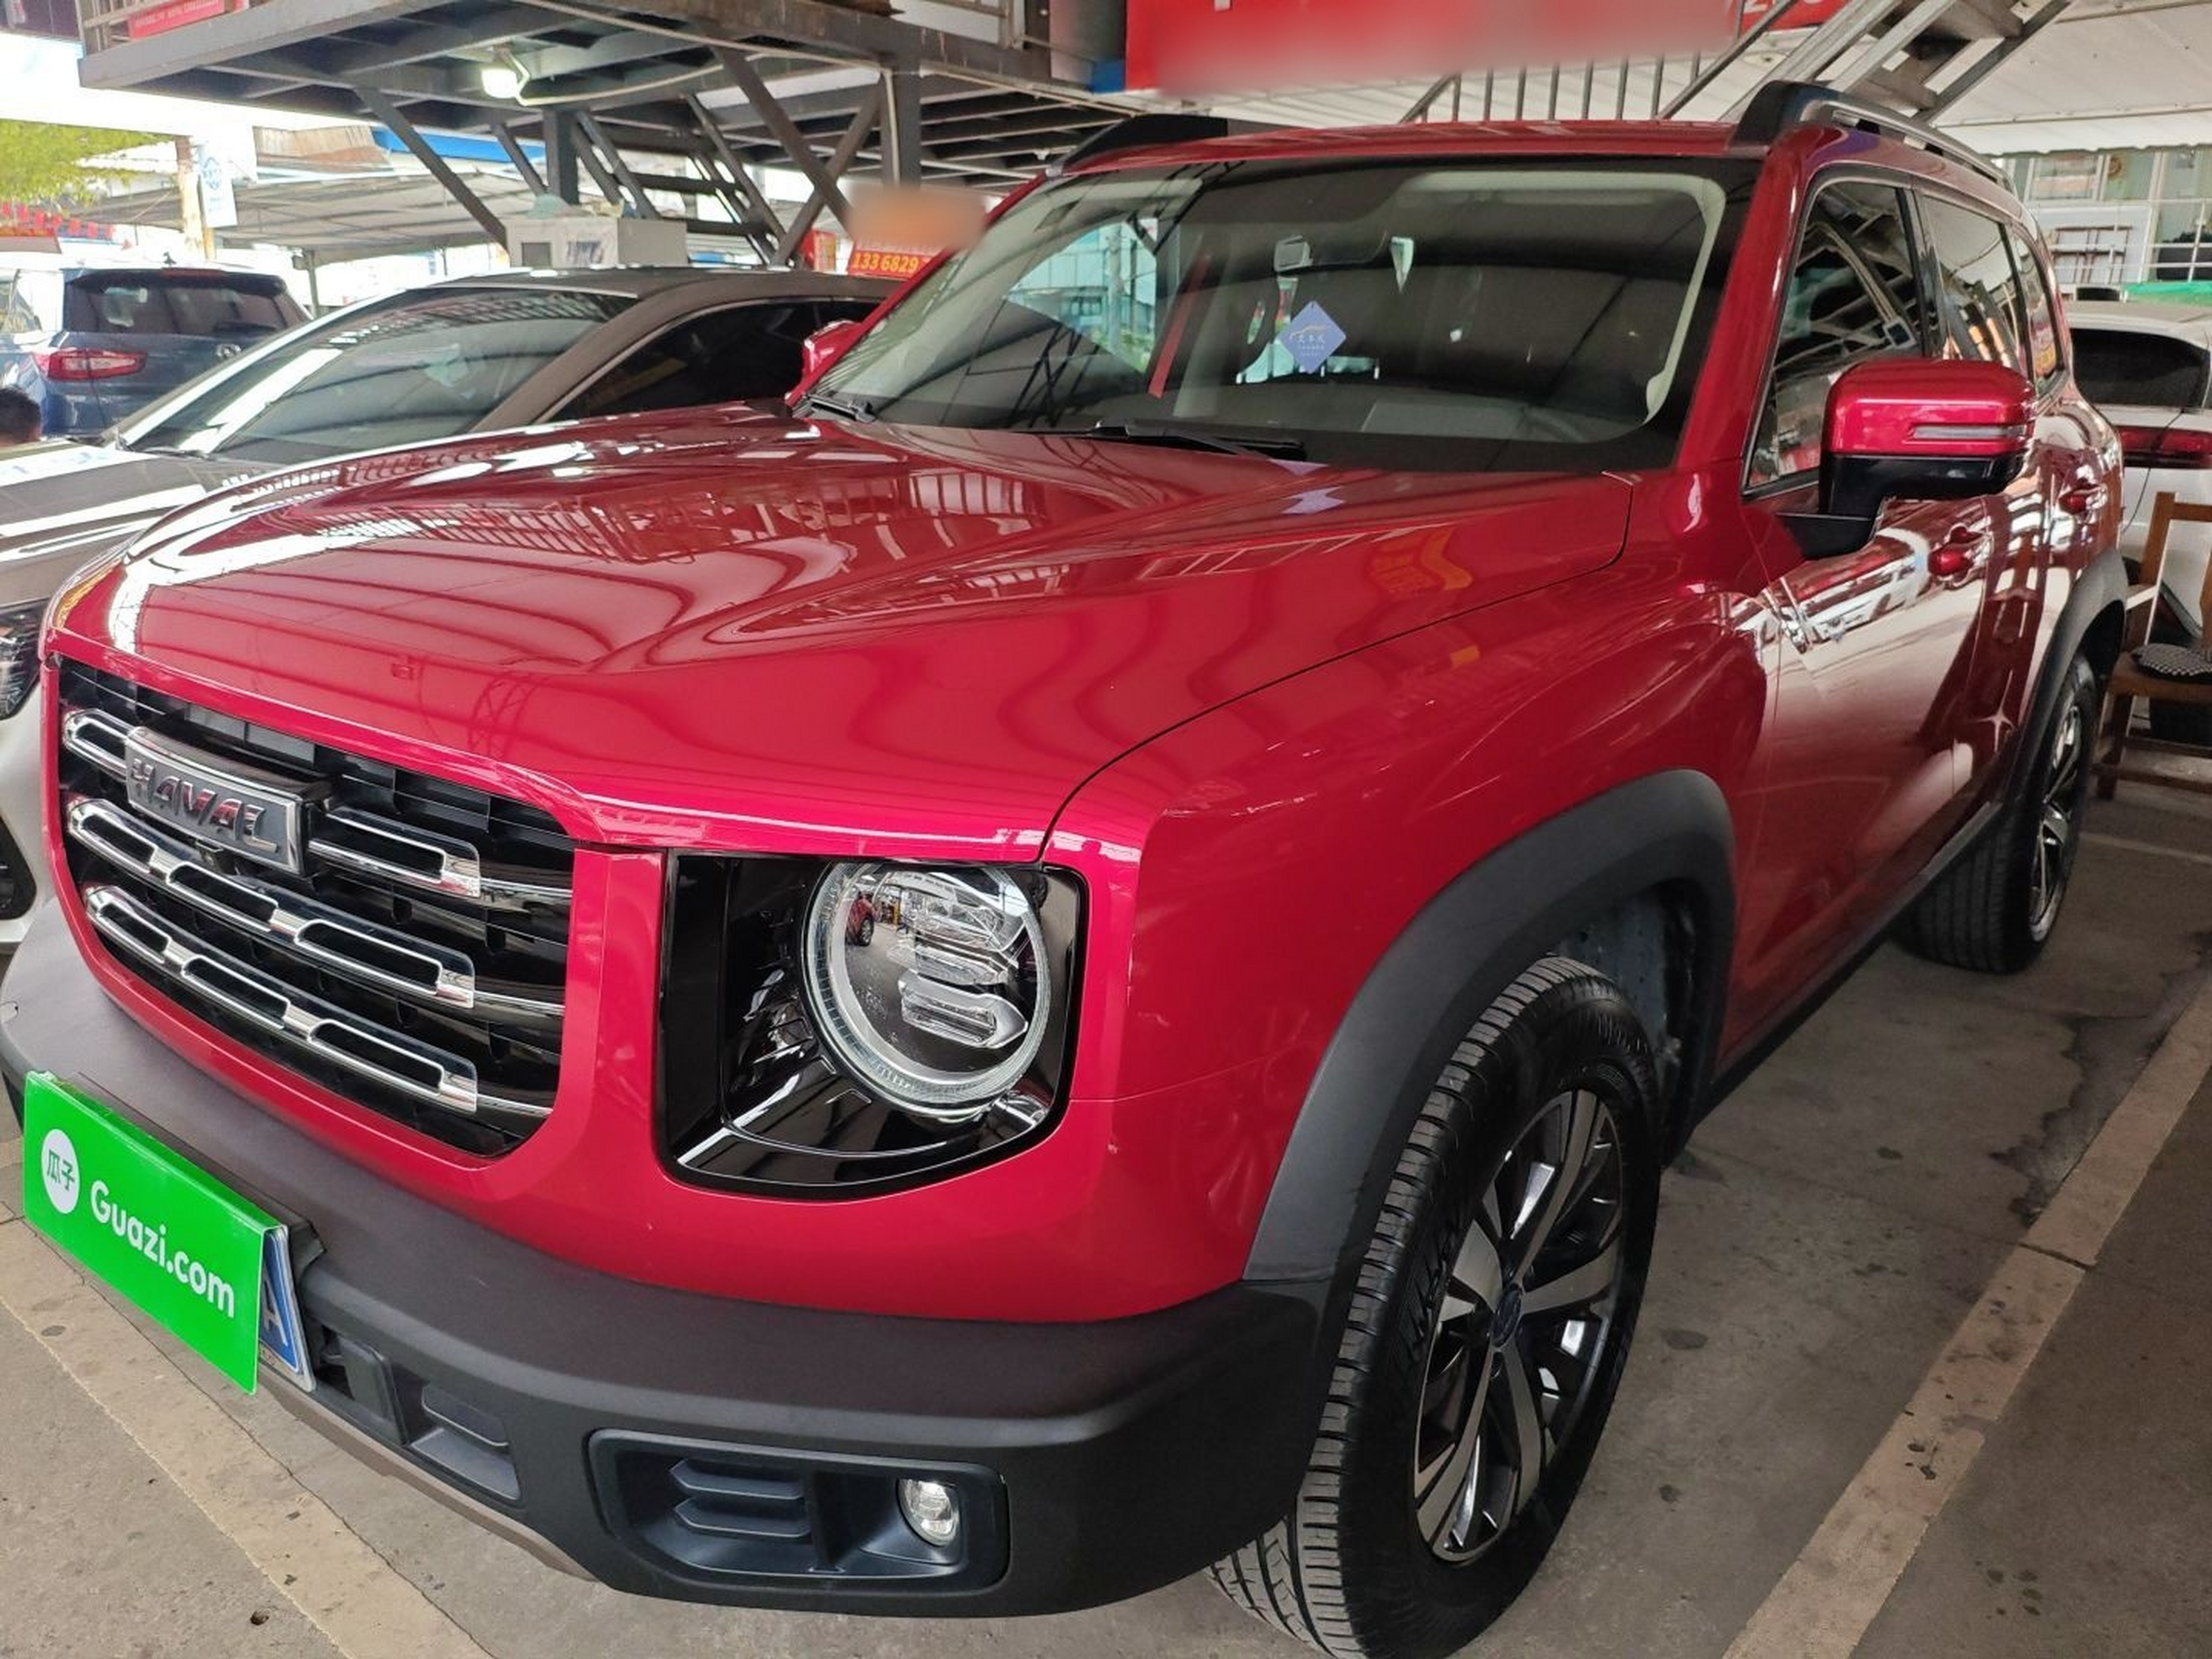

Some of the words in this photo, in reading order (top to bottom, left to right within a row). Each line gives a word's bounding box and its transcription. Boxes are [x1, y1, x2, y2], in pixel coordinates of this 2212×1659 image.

[130, 757, 278, 853] HAVAL
[47, 1149, 75, 1191] 瓜子
[90, 1180, 234, 1319] Guazi.com
